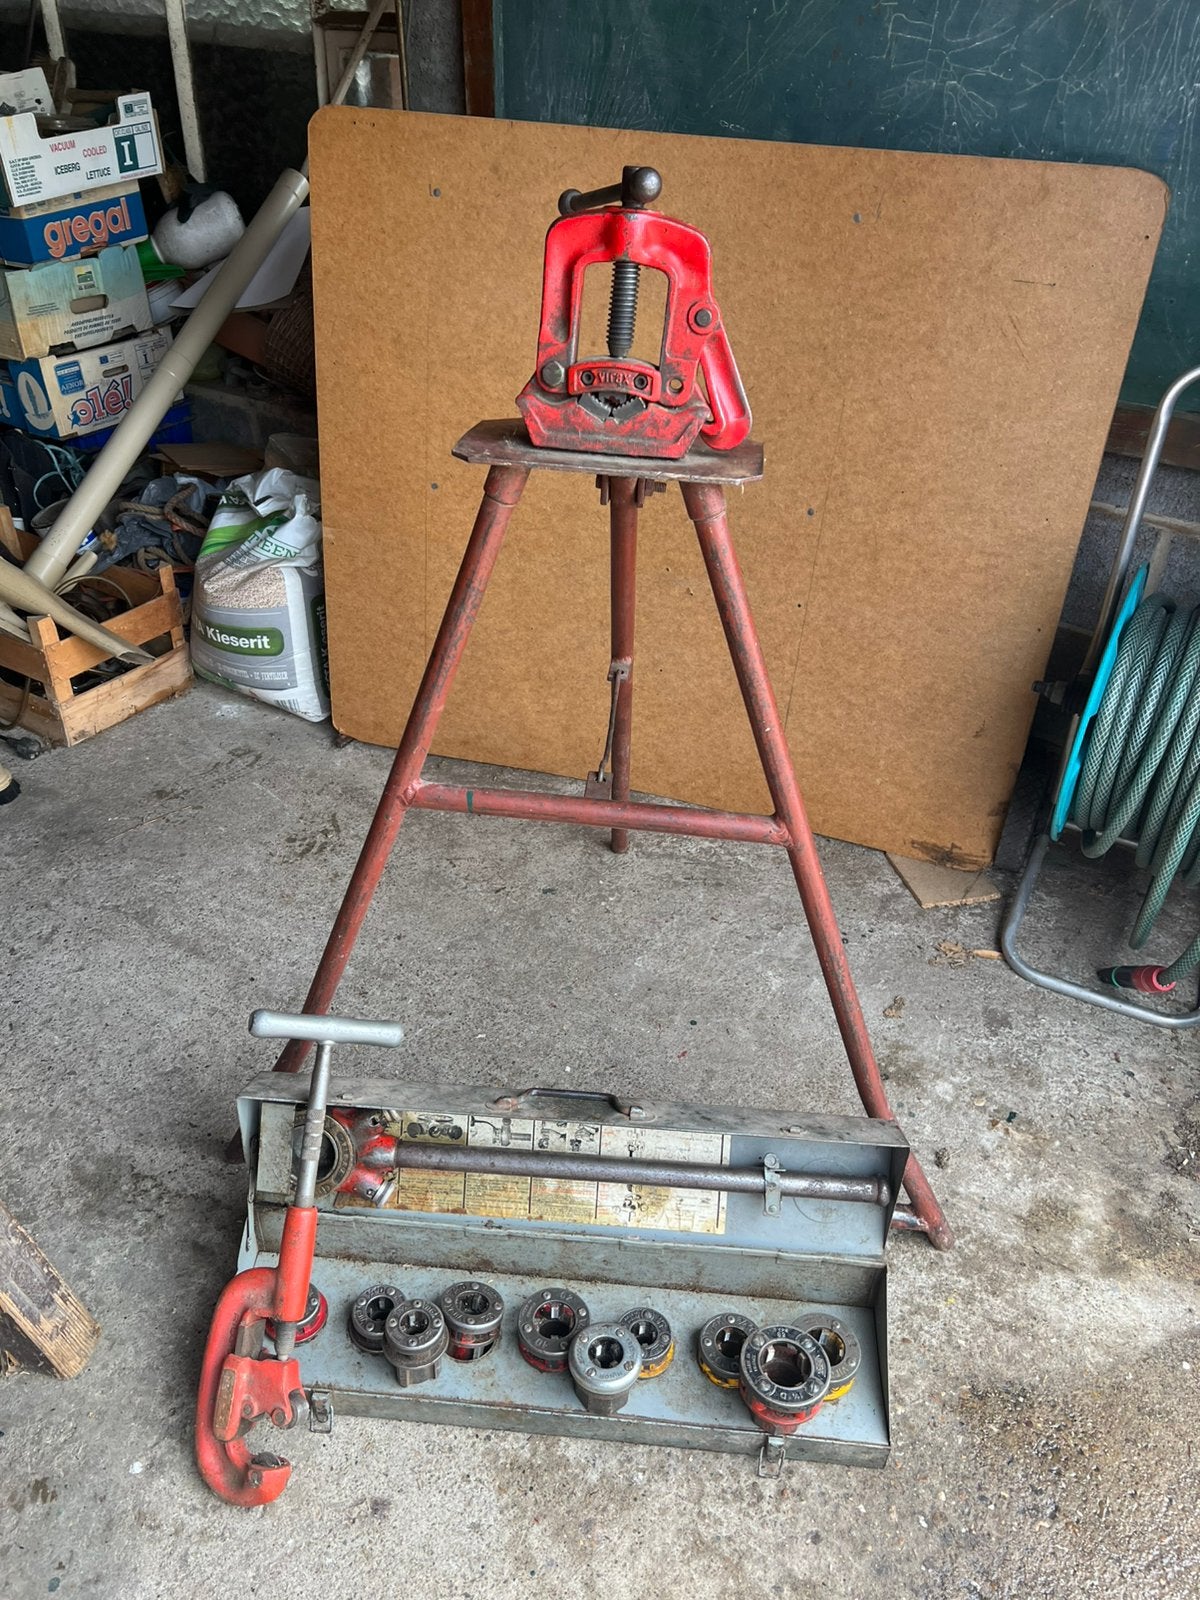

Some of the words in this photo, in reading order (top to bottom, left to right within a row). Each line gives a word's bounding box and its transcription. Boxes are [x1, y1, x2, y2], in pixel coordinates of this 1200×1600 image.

[50, 139, 76, 153] VACUUM
[82, 145, 108, 158] COOLED
[121, 141, 134, 166] I
[54, 162, 81, 176] ICEBERG
[86, 167, 111, 181] LETTUCE
[43, 197, 132, 258] gregal
[71, 374, 133, 426] olé!
[206, 625, 271, 650] Kieserit
